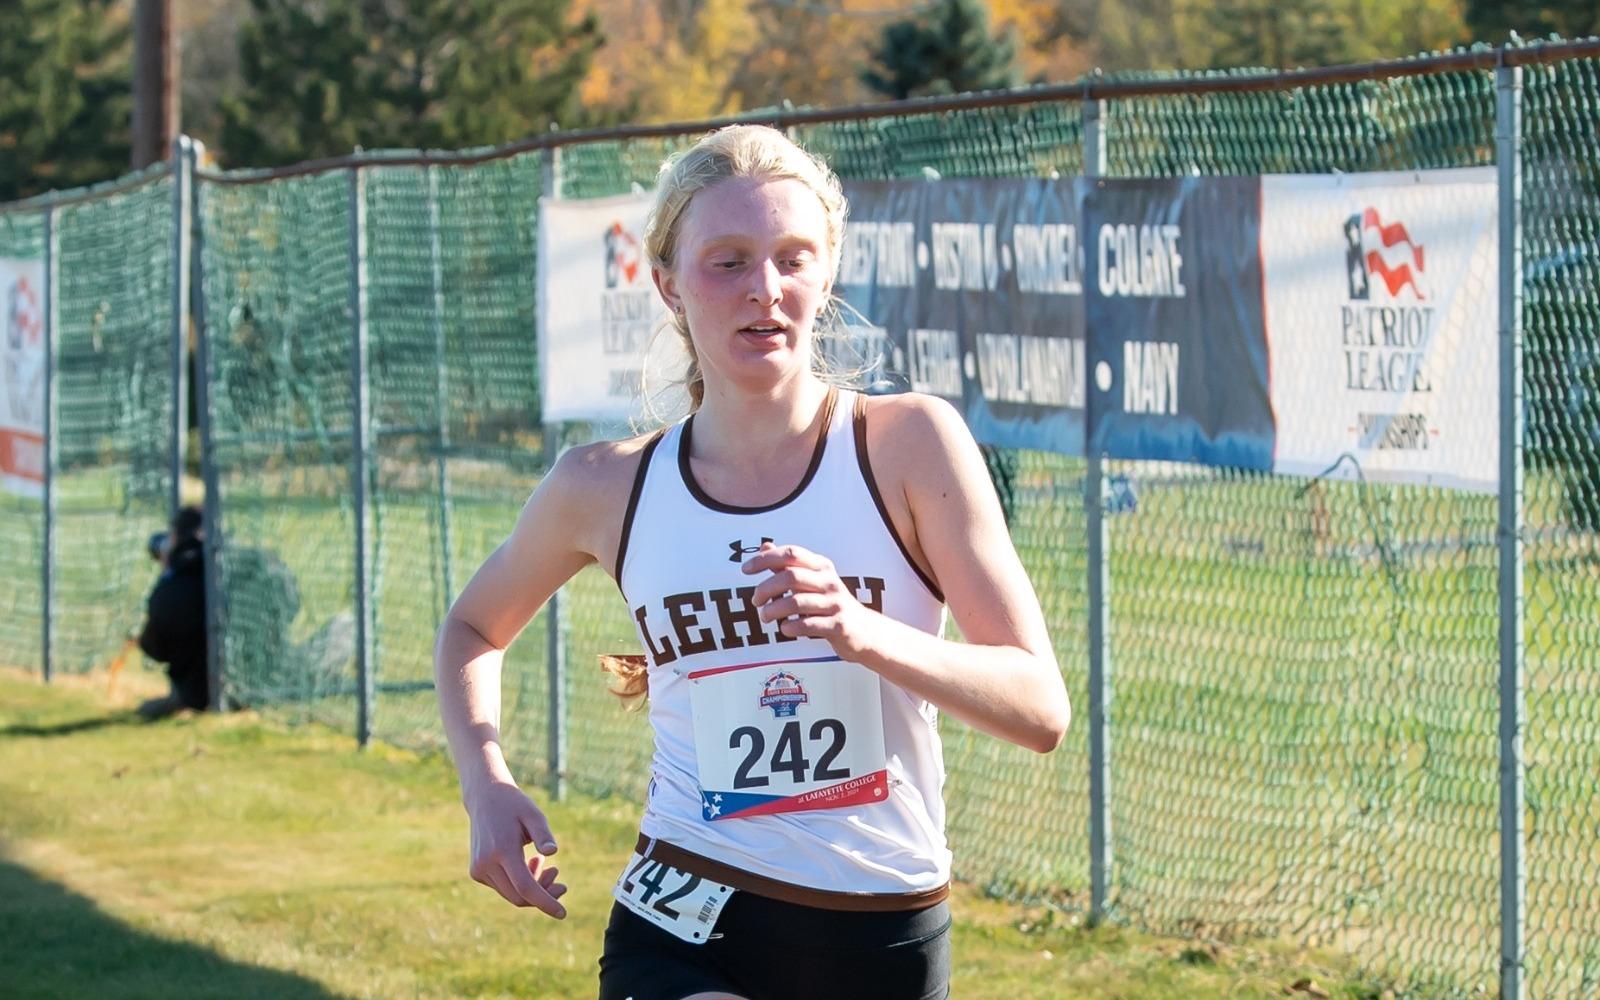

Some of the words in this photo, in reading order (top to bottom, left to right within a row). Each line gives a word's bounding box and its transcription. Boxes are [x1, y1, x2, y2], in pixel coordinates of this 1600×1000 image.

[1098, 224, 1186, 297] COLGATE
[1341, 306, 1434, 347] PATRIOT
[1123, 341, 1181, 415] NAVY
[635, 577, 885, 667] LEHH
[729, 718, 850, 789] 242
[805, 785, 844, 802] LAFAYETTE
[844, 775, 876, 790] COLLEGE
